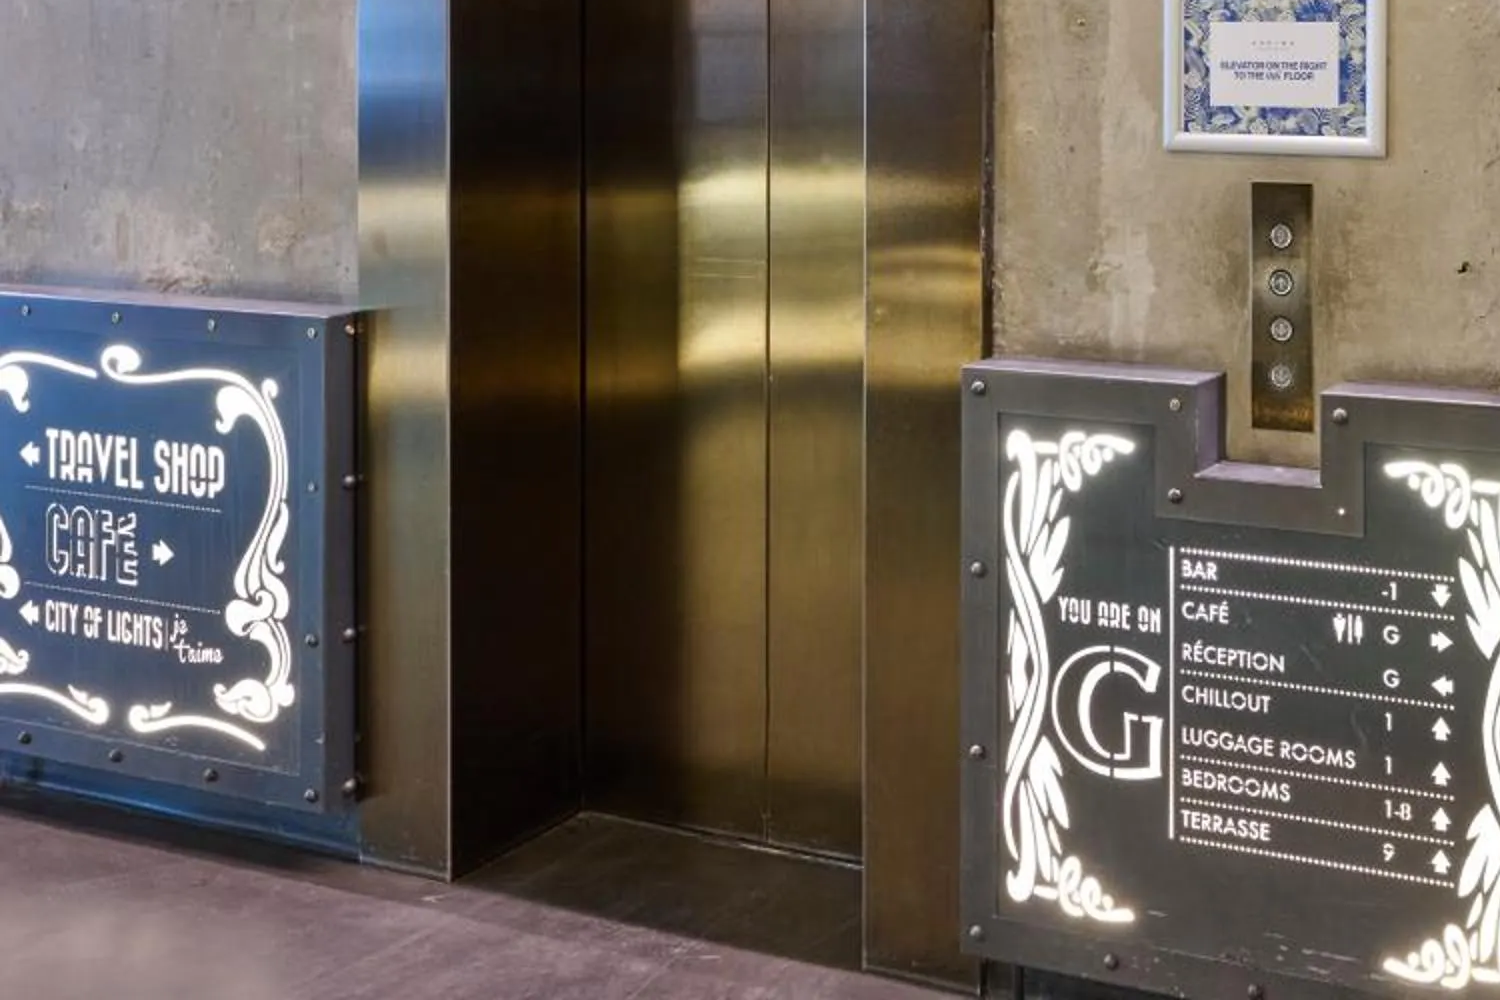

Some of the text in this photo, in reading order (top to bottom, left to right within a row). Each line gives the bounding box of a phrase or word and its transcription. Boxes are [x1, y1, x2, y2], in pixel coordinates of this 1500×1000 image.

[46, 428, 225, 498] TRAVEL SHOP
[46, 503, 139, 586] CAFÉ
[1181, 559, 1397, 600] BAR -1
[45, 600, 163, 649] CITY OF LIGHTS
[1058, 597, 1161, 632] YOU ARE ON
[1181, 600, 1400, 645] CAFÉ G
[1182, 641, 1400, 689] RÉCEPTION G
[1052, 645, 1164, 780] G
[1181, 686, 1393, 731] CHILLOUT 1
[1181, 727, 1393, 775] LUGGAGE ROOMS 1
[1181, 769, 1291, 801] BEDROOMS
[1180, 810, 1395, 862] TERRASSE 9
